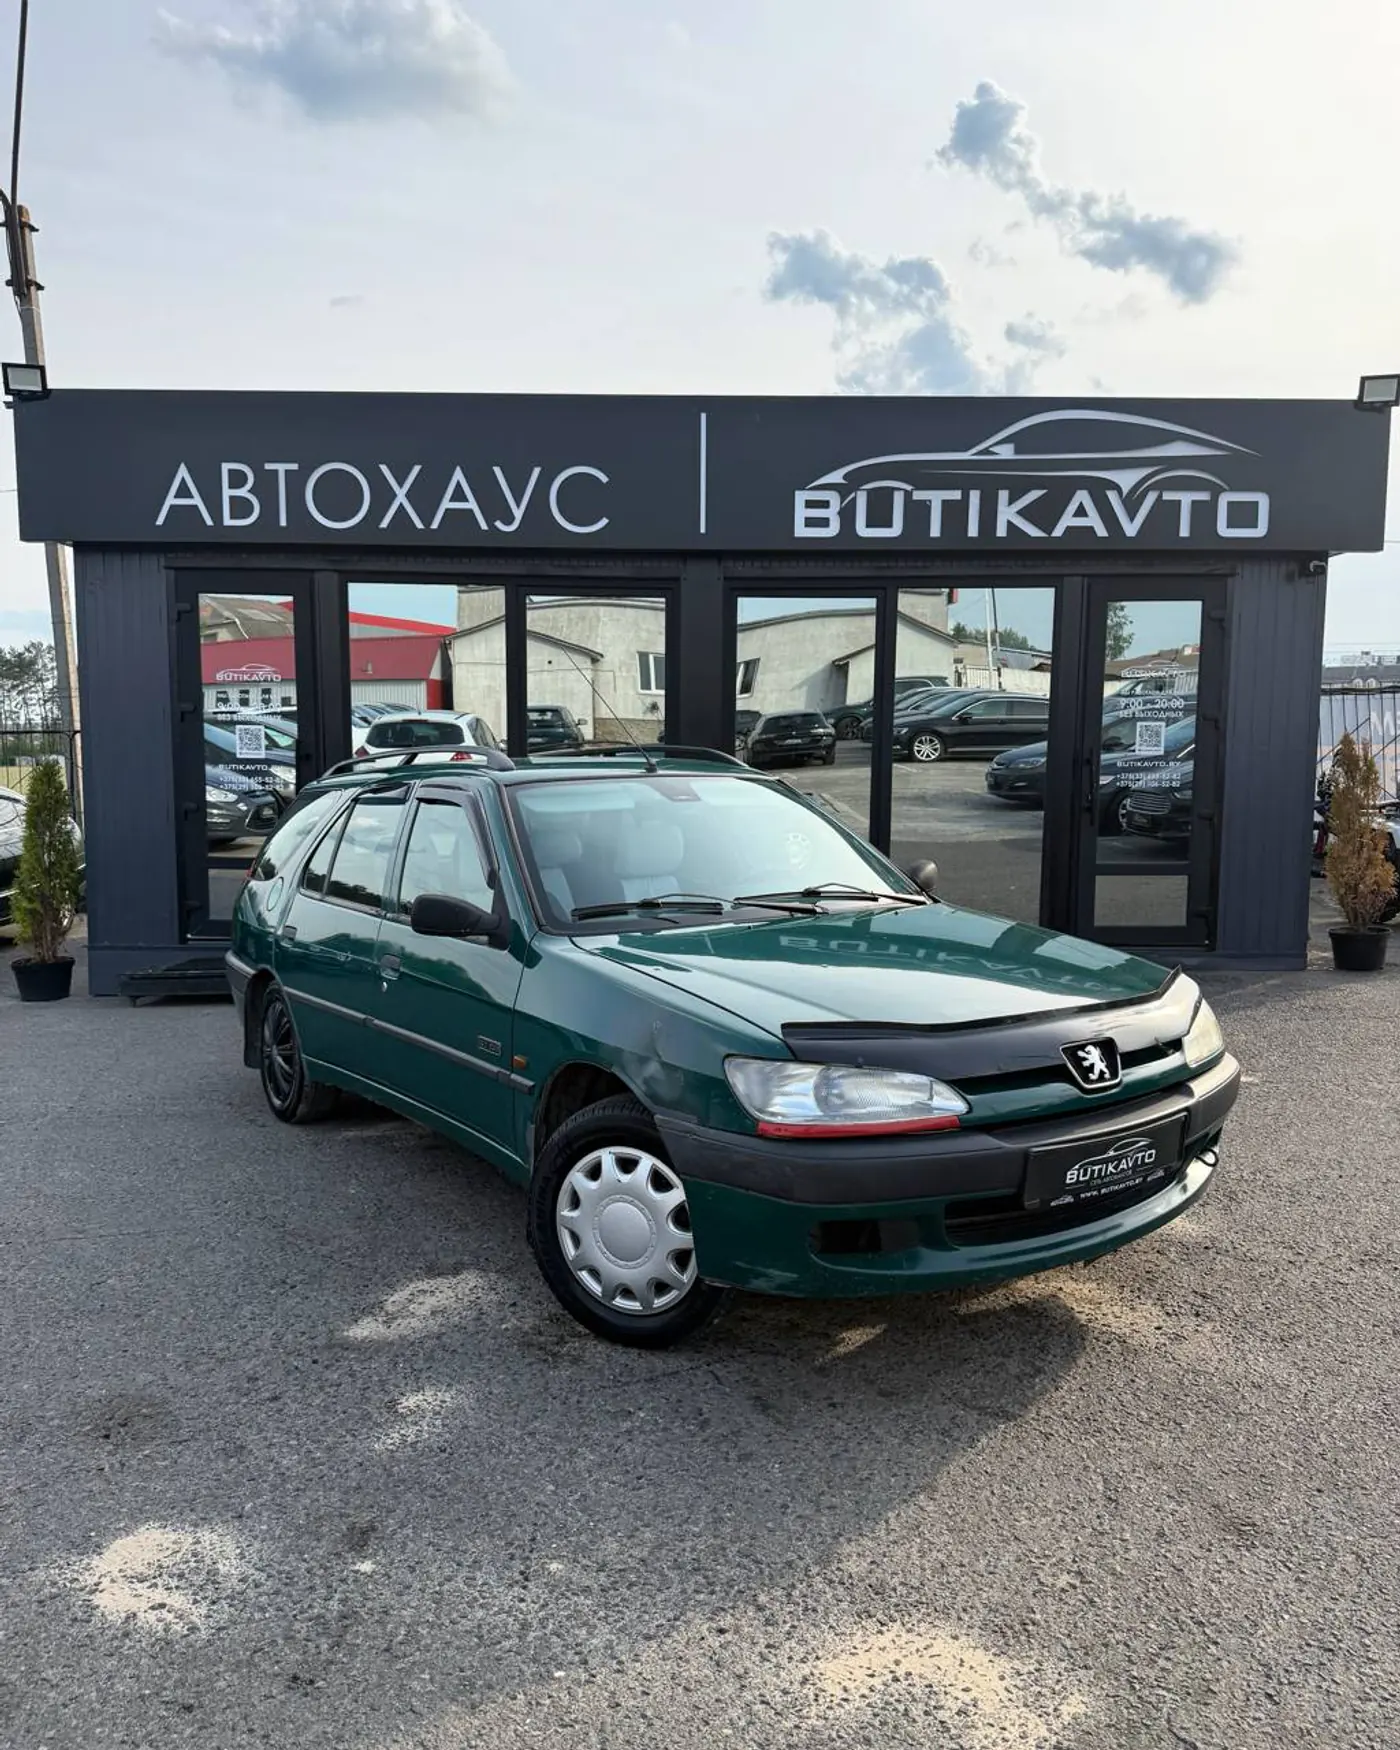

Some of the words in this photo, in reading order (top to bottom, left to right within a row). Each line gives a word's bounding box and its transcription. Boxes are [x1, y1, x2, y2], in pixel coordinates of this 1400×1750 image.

[155, 461, 611, 534] АВТОХАУС
[793, 486, 1270, 540] BUTIKAVTO
[216, 673, 282, 682] BUTIKAVTO
[1119, 698, 1143, 709] 9:00
[1065, 1148, 1157, 1184] BUTIKAVTO
